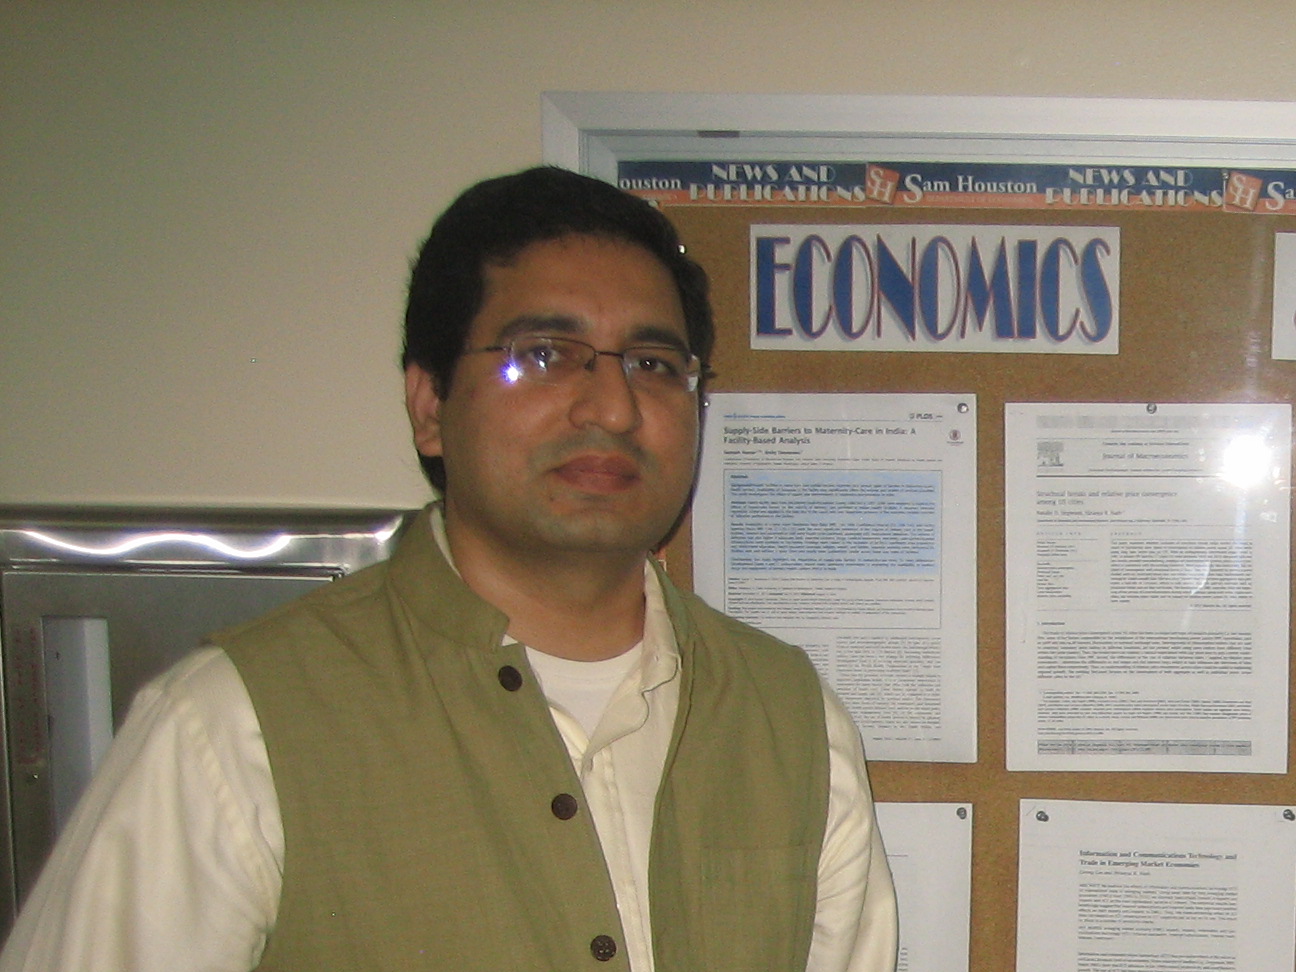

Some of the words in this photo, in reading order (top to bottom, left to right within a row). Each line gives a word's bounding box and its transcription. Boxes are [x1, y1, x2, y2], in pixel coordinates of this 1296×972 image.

[711, 164, 779, 182] NEWS
[785, 165, 836, 182] AND
[1068, 167, 1135, 187] NEWS
[1142, 169, 1193, 187] AND
[689, 183, 866, 202] PUBLICATIONS
[903, 173, 950, 203] Sam
[957, 175, 1038, 194] Houston
[1045, 187, 1223, 208] PUBLICATIONS
[756, 234, 1113, 344] ECONOMICS
